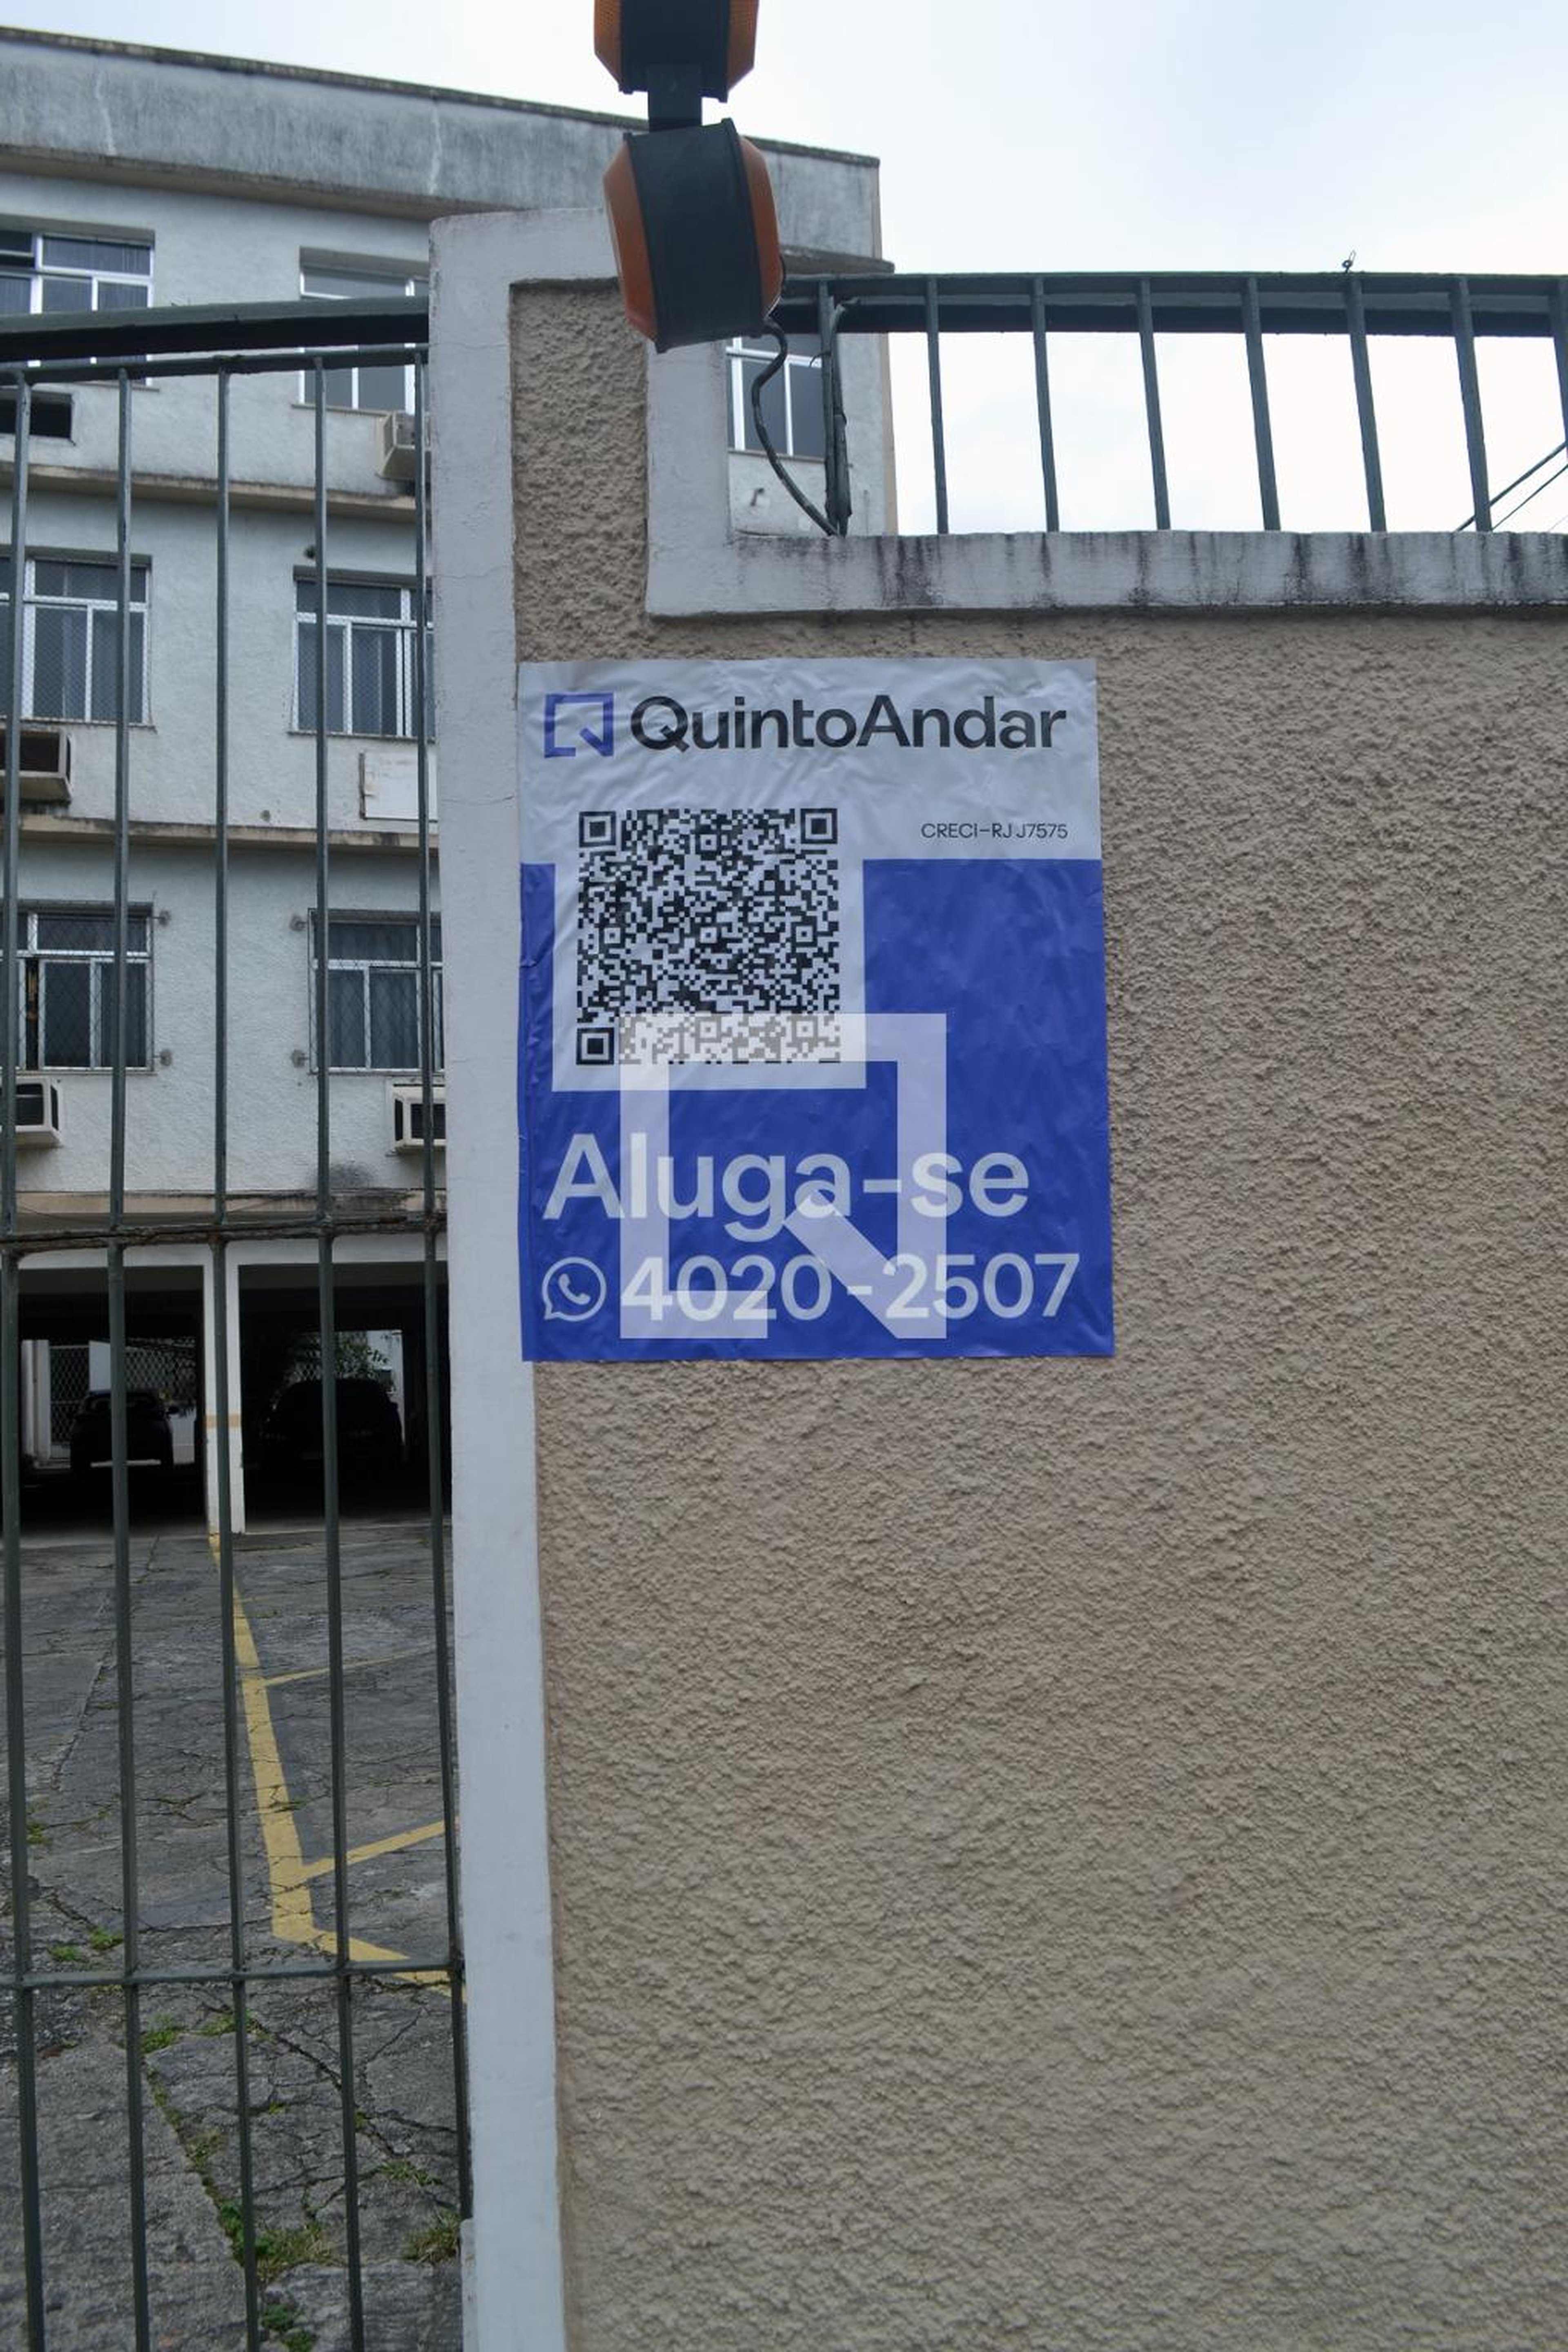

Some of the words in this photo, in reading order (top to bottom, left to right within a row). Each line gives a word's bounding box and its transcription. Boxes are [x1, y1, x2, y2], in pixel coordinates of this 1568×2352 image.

[630, 694, 1067, 752] QuintoAndar
[921, 823, 1012, 838] CRECI-RJ
[542, 1133, 1029, 1242] Aluga-se
[620, 1253, 1080, 1321] 4020-2507
